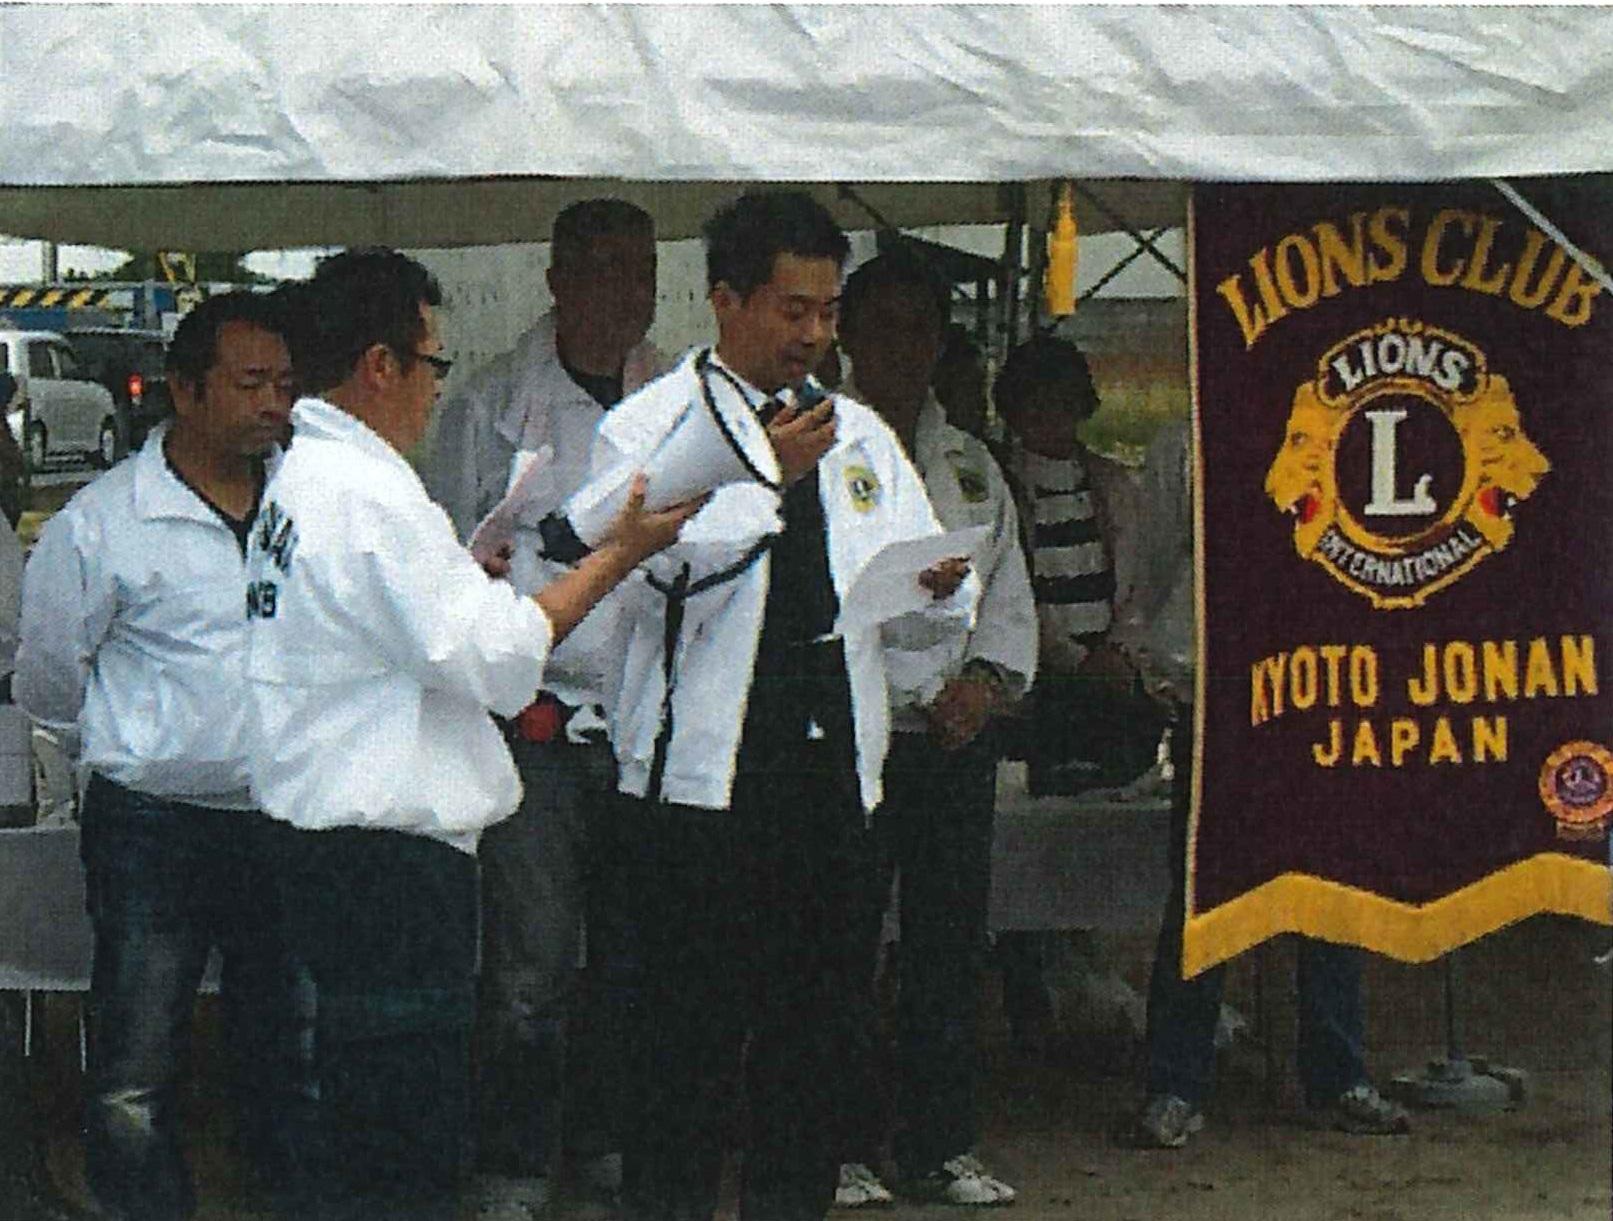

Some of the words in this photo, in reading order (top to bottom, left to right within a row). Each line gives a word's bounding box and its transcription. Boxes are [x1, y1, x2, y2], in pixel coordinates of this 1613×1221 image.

[1216, 208, 1410, 350] LIONS
[1420, 208, 1602, 328] CLUB
[1331, 333, 1470, 392] LIONS
[1364, 409, 1438, 516] L
[1317, 527, 1483, 587] INTERNATIONAL
[1250, 644, 1378, 727] KYOTO
[1407, 634, 1599, 706] JONAN
[1311, 715, 1509, 768] JAPAN
